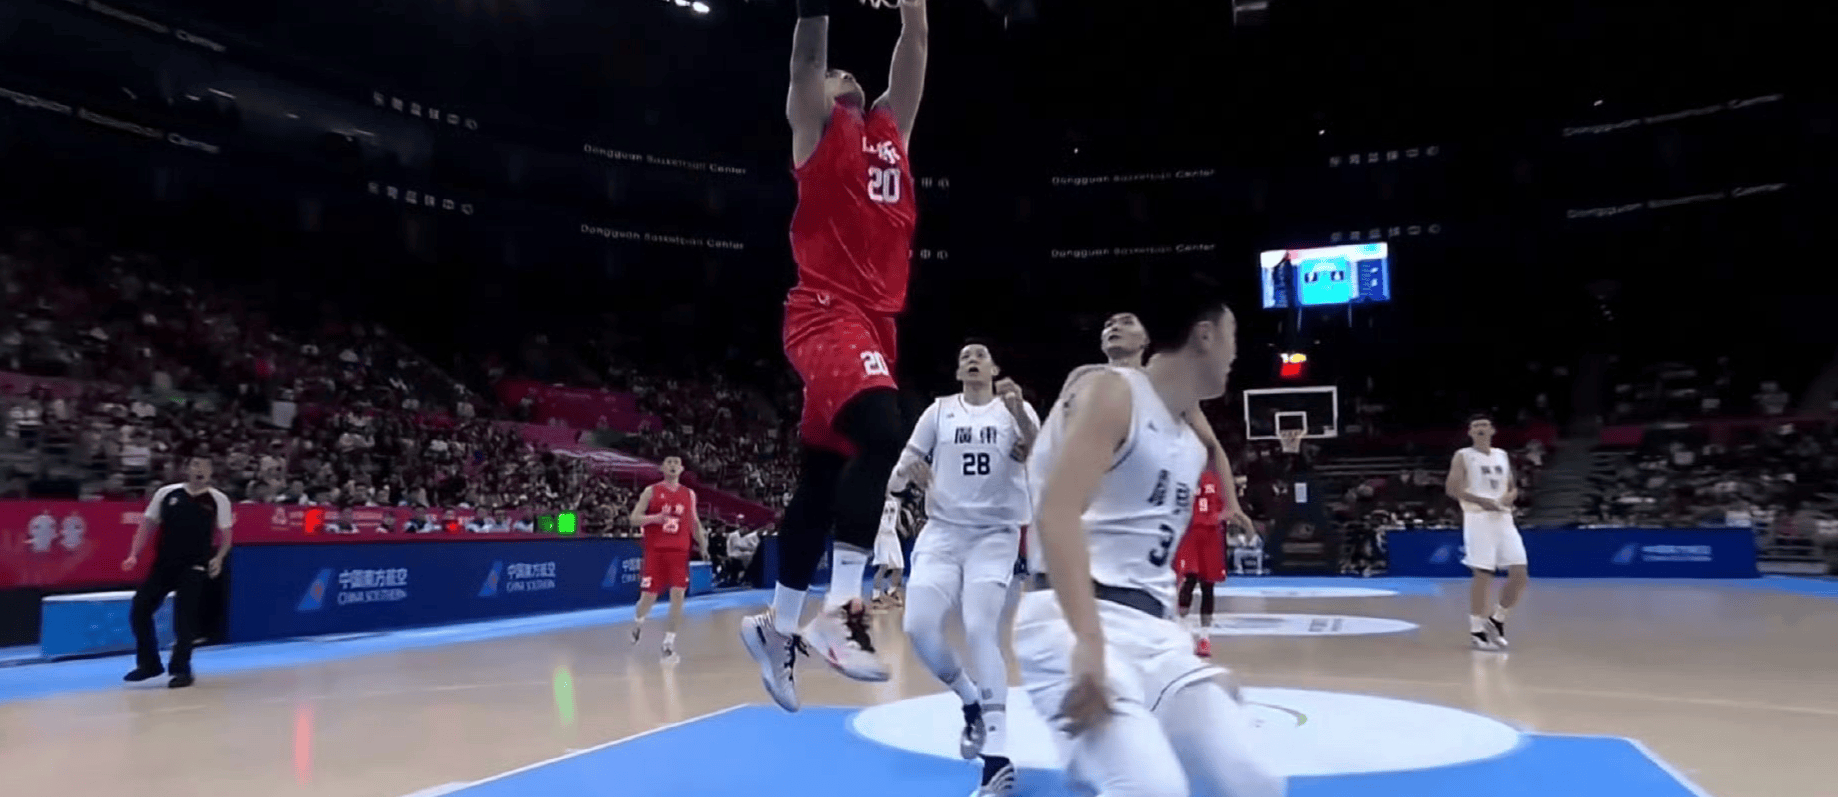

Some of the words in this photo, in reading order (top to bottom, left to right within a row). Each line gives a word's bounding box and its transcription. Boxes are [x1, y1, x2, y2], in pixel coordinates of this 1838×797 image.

[867, 166, 901, 203] 20
[860, 350, 889, 376] 20
[962, 452, 991, 476] 28
